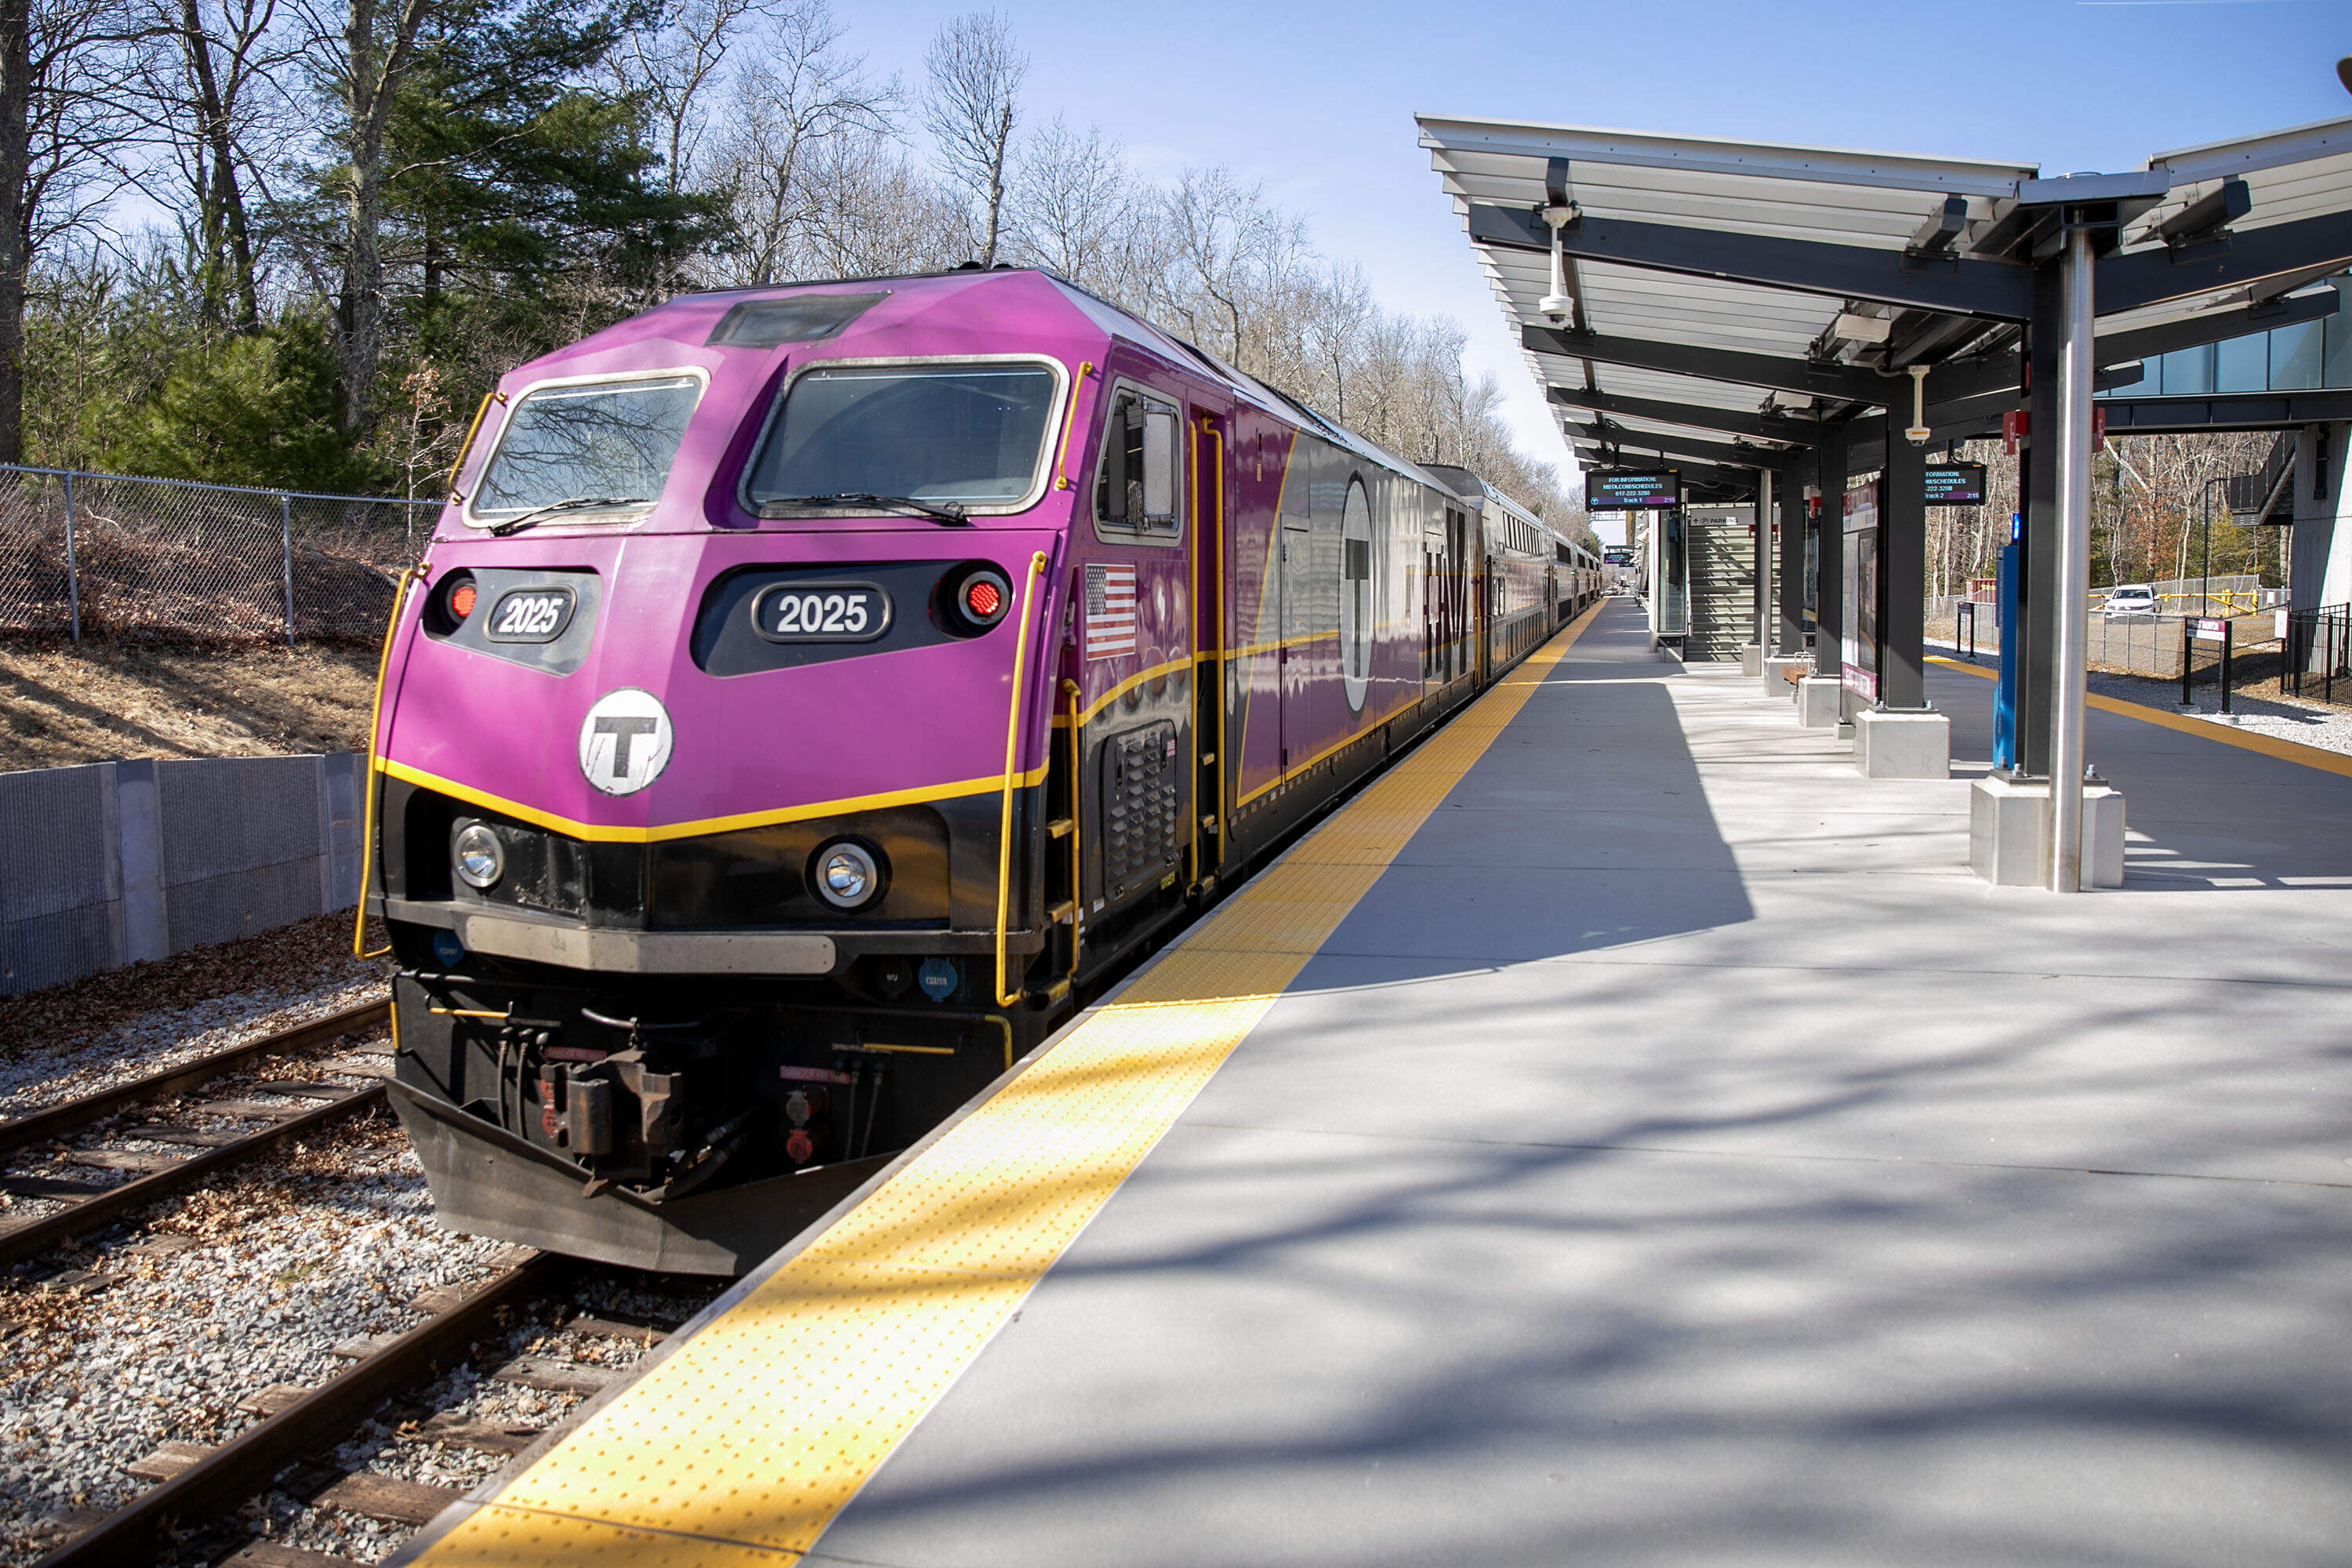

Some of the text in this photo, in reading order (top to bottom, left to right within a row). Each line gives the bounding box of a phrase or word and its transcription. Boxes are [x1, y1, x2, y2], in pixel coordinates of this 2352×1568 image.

[499, 597, 564, 633] 2025
[777, 594, 868, 633] 2025
[1345, 538, 1369, 677] T
[594, 716, 658, 778] T
